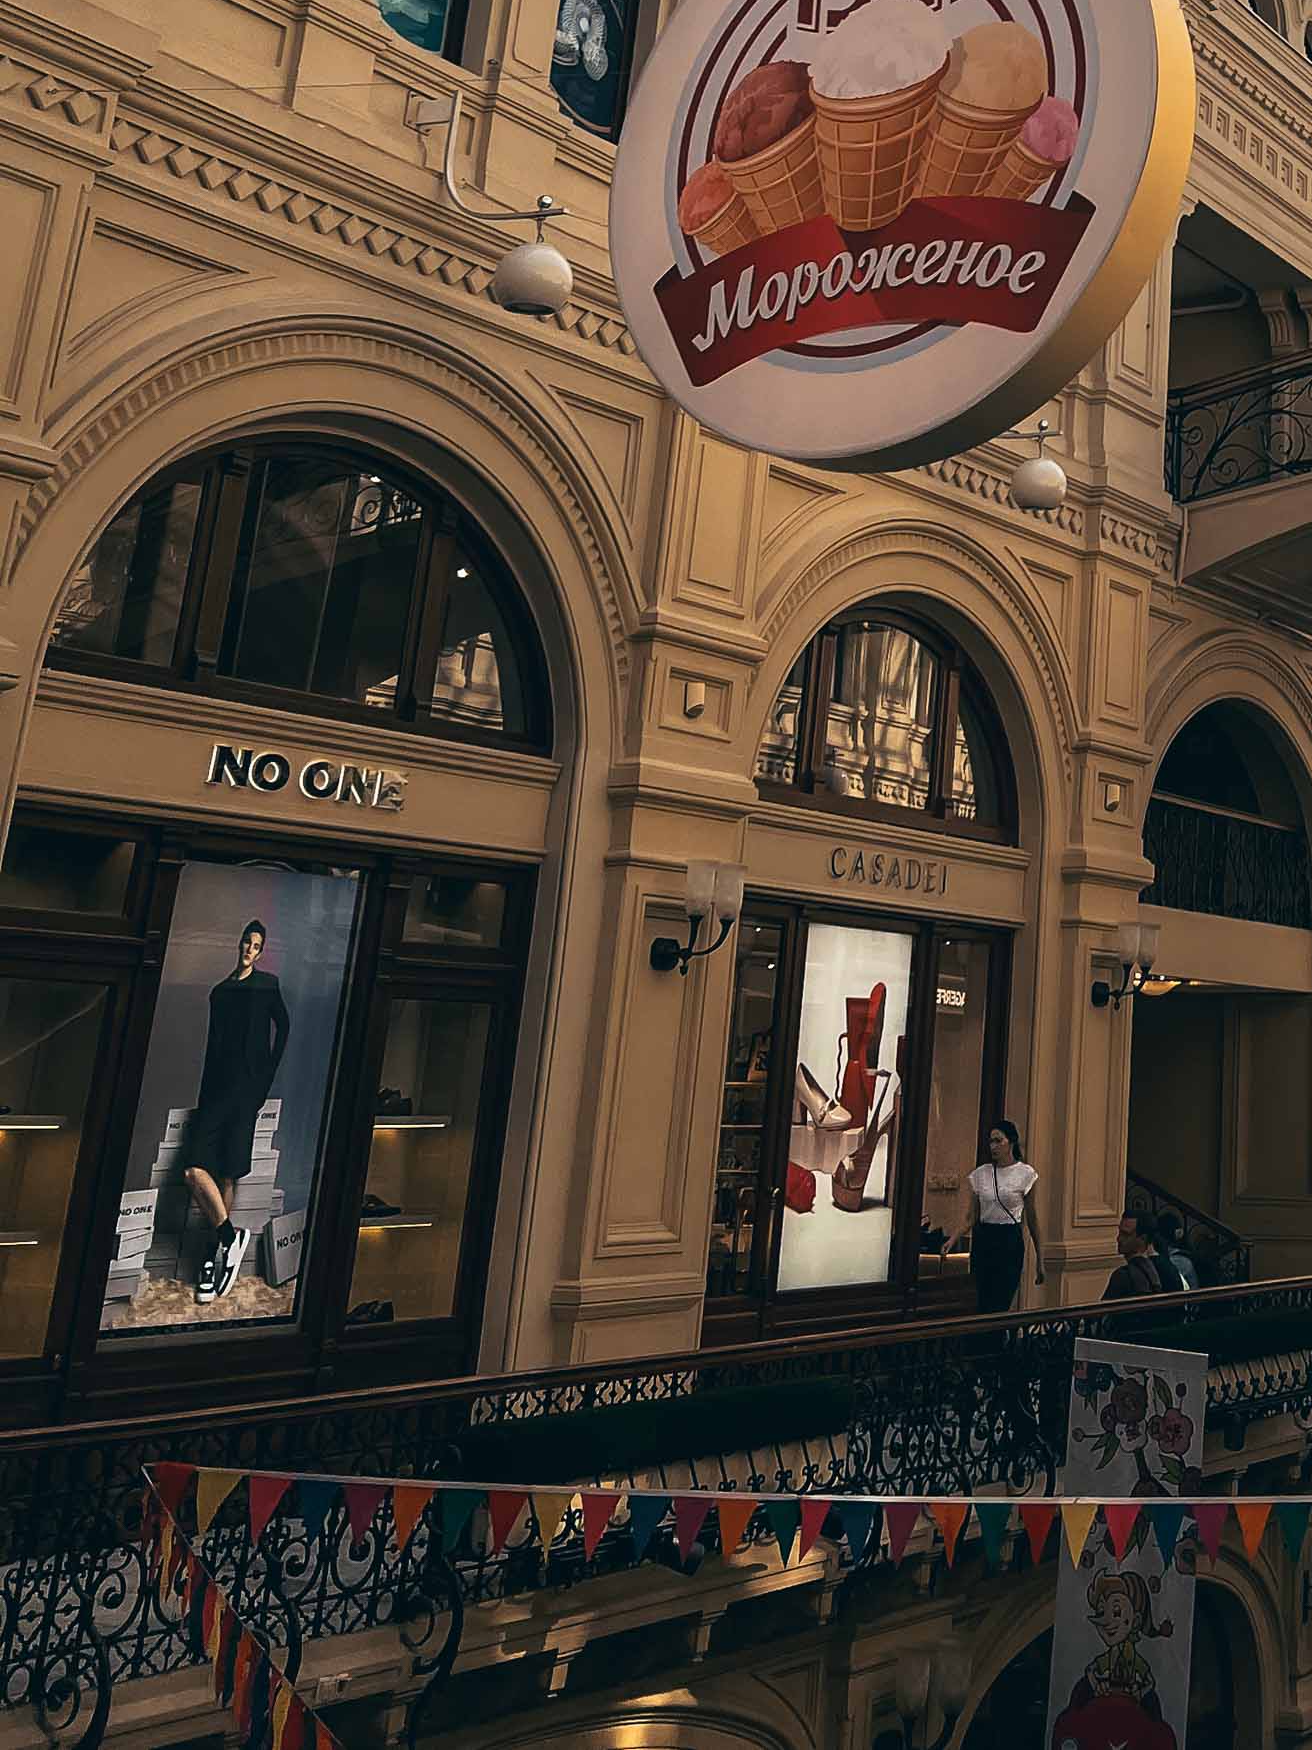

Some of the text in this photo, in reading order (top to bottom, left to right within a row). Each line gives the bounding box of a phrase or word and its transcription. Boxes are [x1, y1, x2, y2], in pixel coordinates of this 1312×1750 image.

[691, 240, 1047, 352] Мороженое
[204, 743, 408, 812] NO ONE
[828, 846, 950, 897] CASADEI
